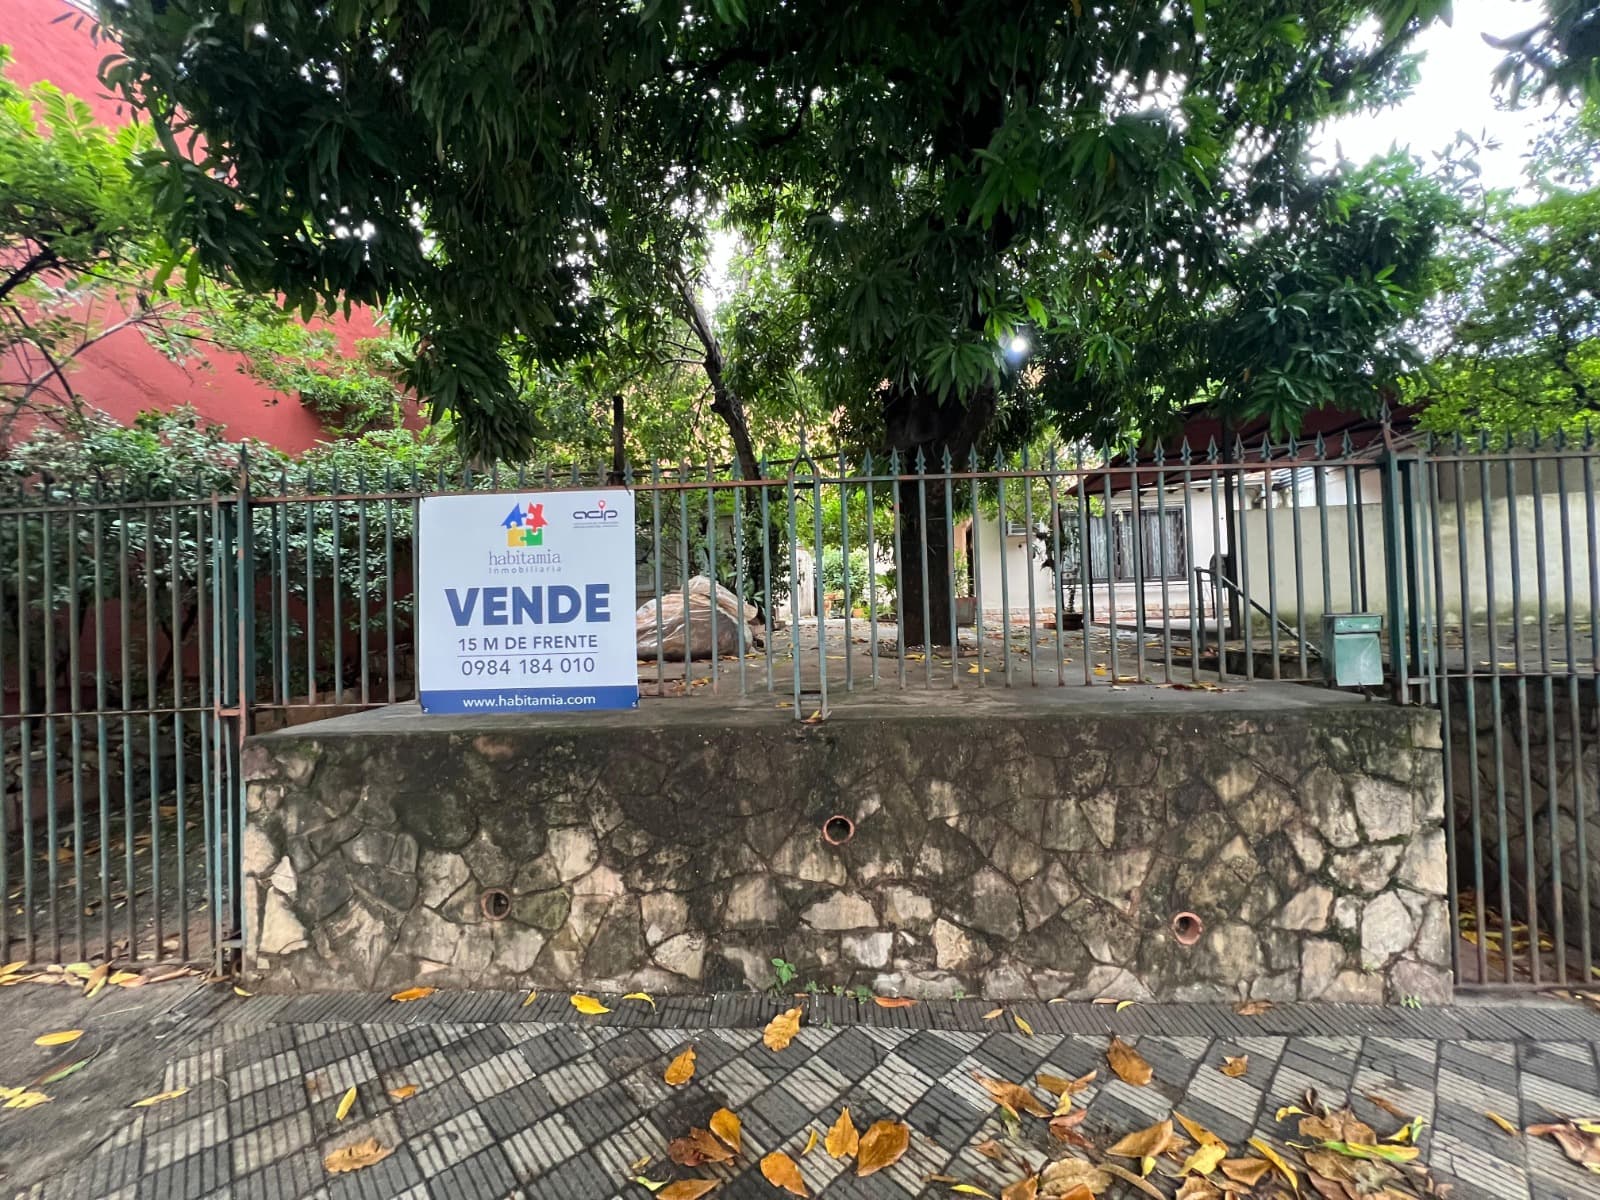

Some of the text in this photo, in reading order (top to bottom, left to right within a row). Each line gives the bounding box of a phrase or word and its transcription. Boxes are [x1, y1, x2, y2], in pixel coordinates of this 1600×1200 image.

[488, 549, 561, 566] habitamia
[445, 583, 611, 626] VENDE
[458, 634, 598, 652] 15 M DE FRENTE
[461, 657, 596, 676] 0984 184 010
[462, 694, 597, 708] www.habitamia.com
